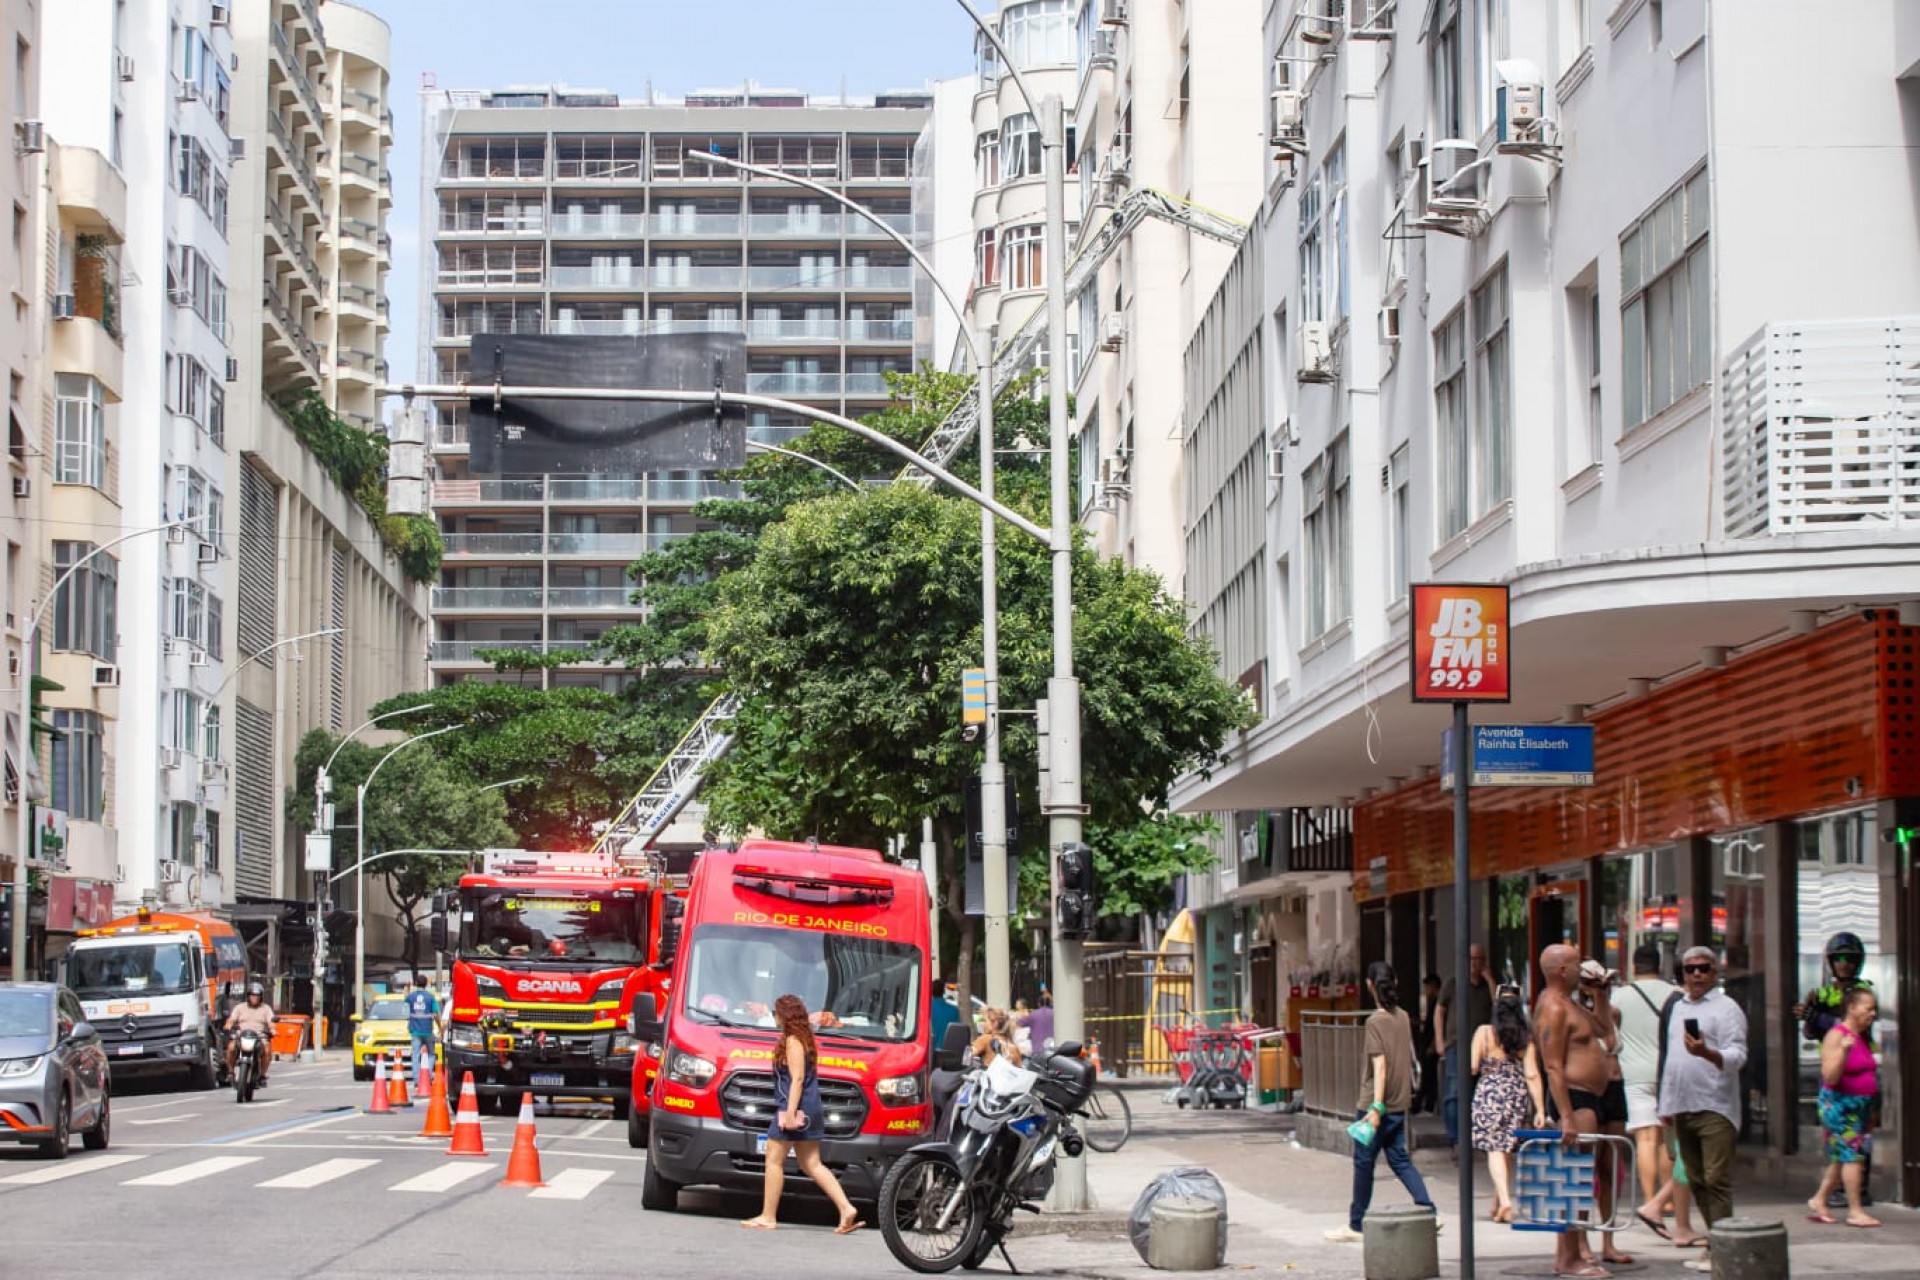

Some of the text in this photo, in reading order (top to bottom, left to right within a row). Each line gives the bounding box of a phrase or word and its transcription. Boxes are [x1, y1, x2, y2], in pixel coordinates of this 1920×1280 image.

[1430, 598, 1482, 637] JB
[1430, 638, 1482, 668] FM
[1430, 669, 1482, 689] 99,9
[1478, 727, 1524, 738] Avenida
[1478, 738, 1569, 749] Rainha Elisabeth
[733, 911, 888, 937] RIO DE JANEIRO
[517, 980, 582, 993] SCANIA
